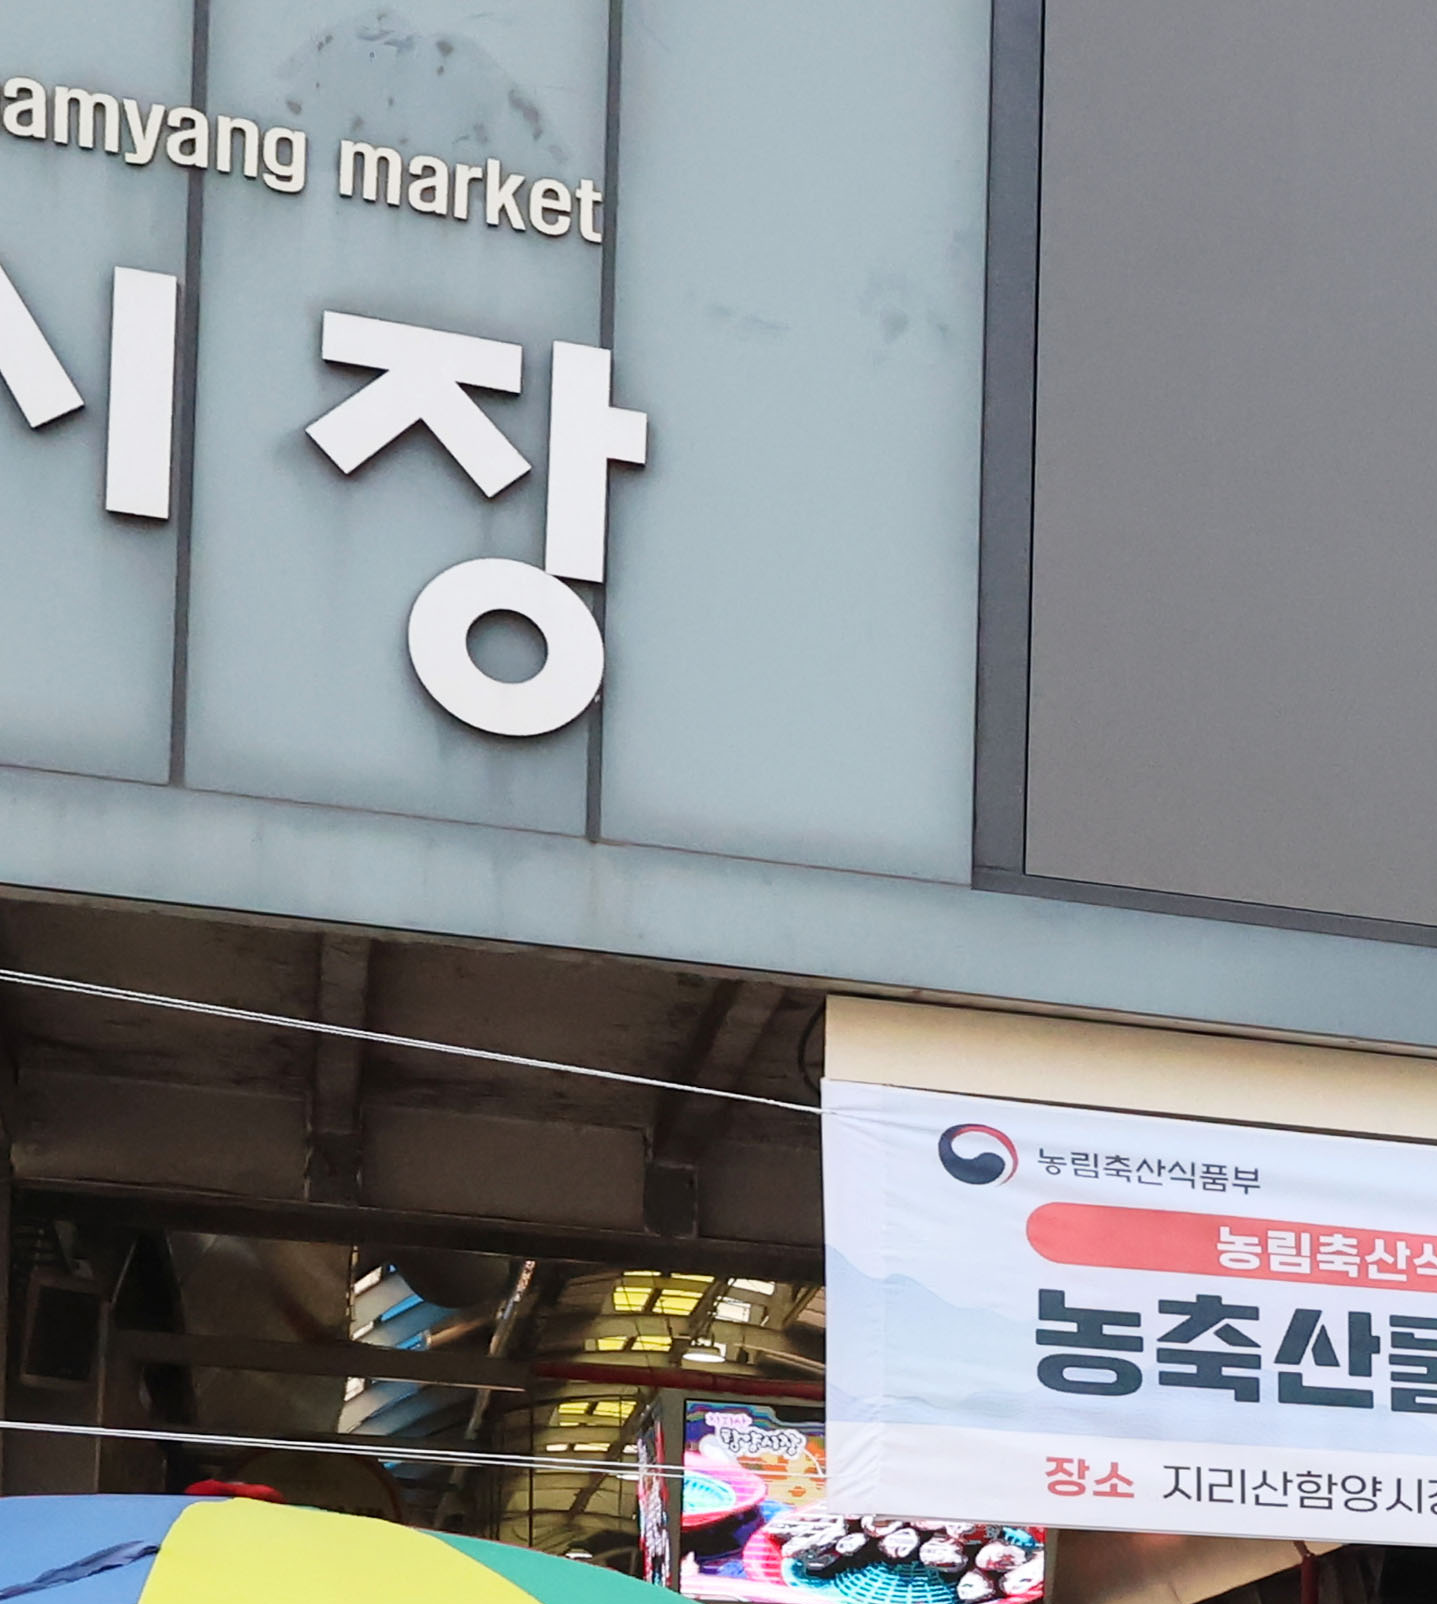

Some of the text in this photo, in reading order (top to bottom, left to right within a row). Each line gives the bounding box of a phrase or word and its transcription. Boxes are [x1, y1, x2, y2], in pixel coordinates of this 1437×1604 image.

[2, 75, 604, 243] amyang market
[0, 264, 648, 737] 시장
[1037, 1147, 1262, 1195] 농림축산식품부
[1045, 1456, 1136, 1501] 장소
